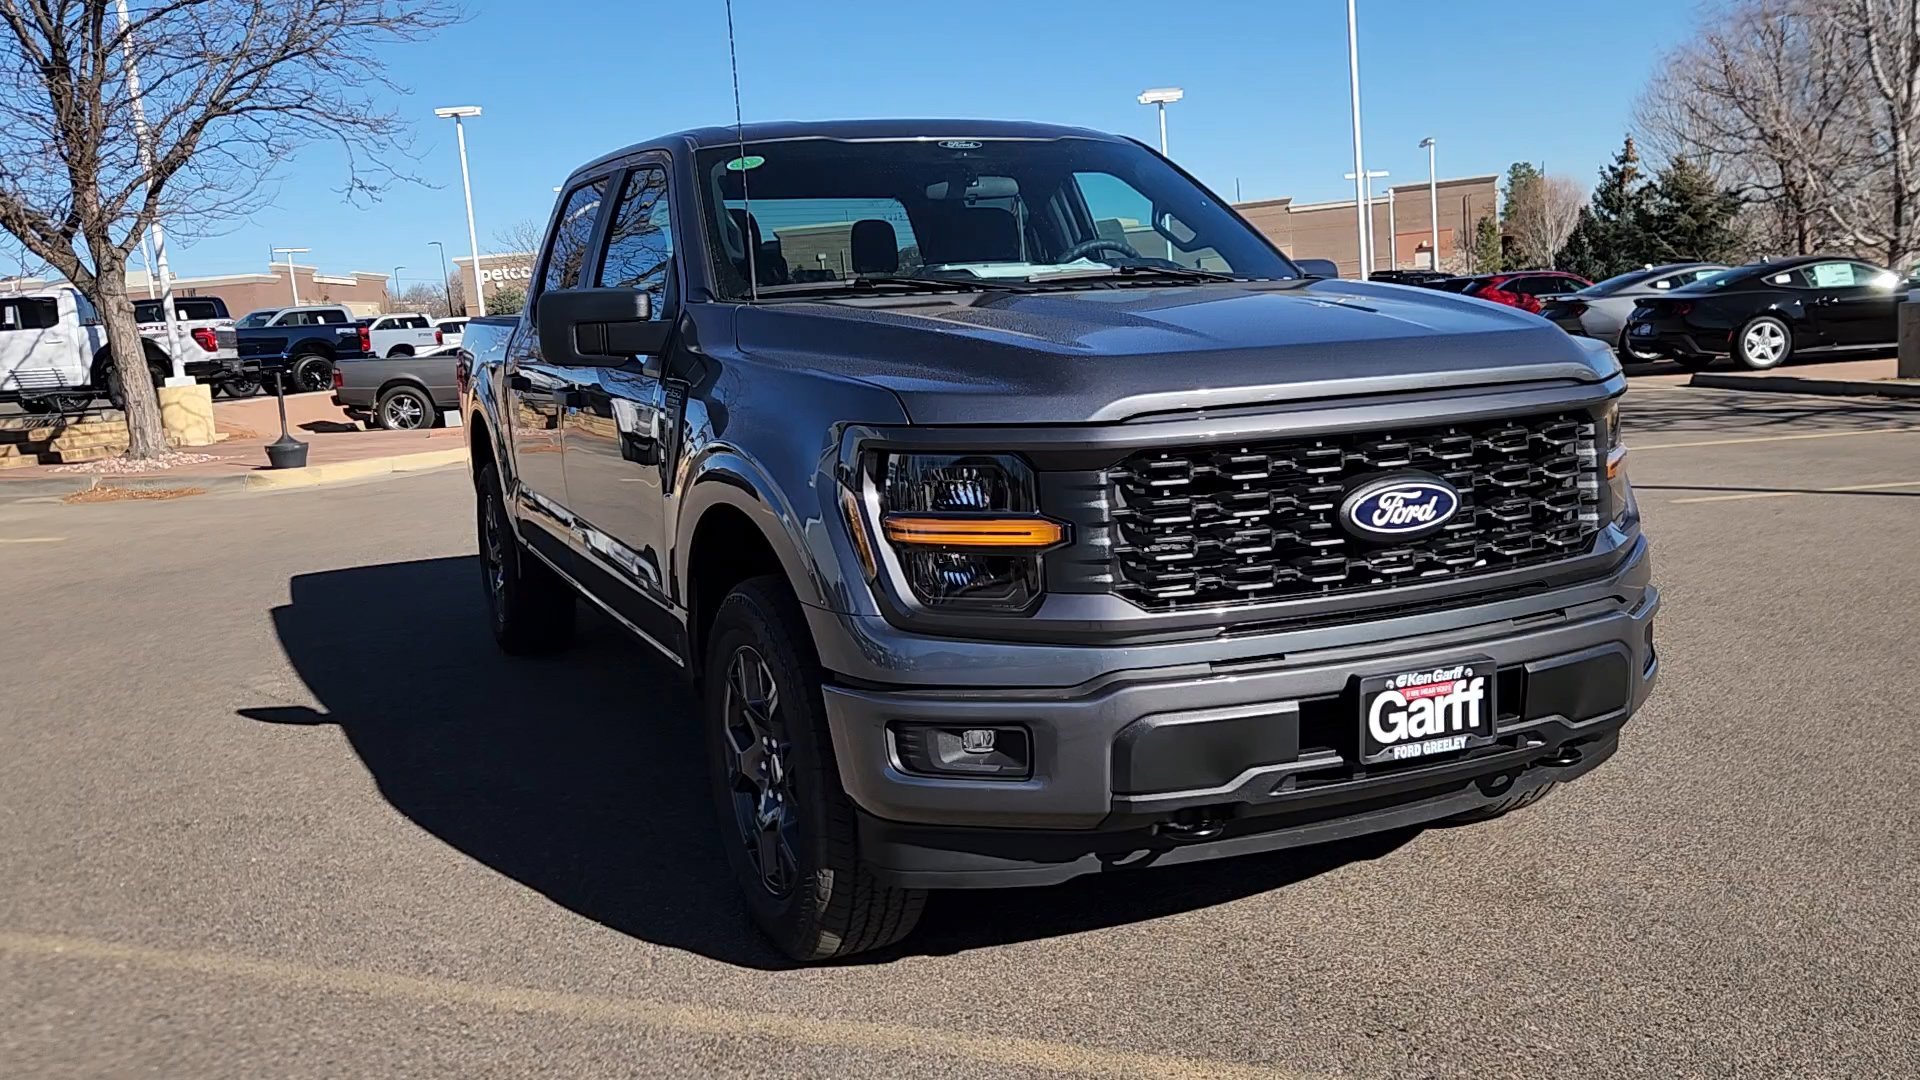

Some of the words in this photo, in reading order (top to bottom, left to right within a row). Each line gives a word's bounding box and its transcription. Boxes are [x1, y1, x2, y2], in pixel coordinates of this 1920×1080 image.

[480, 266, 532, 286] petco
[1372, 490, 1438, 526] Ford
[1407, 673, 1432, 686] Ken
[1433, 666, 1464, 682] Garff
[1369, 677, 1484, 744] Garff
[1394, 744, 1421, 759] FORD
[1423, 736, 1467, 755] GREELEY
